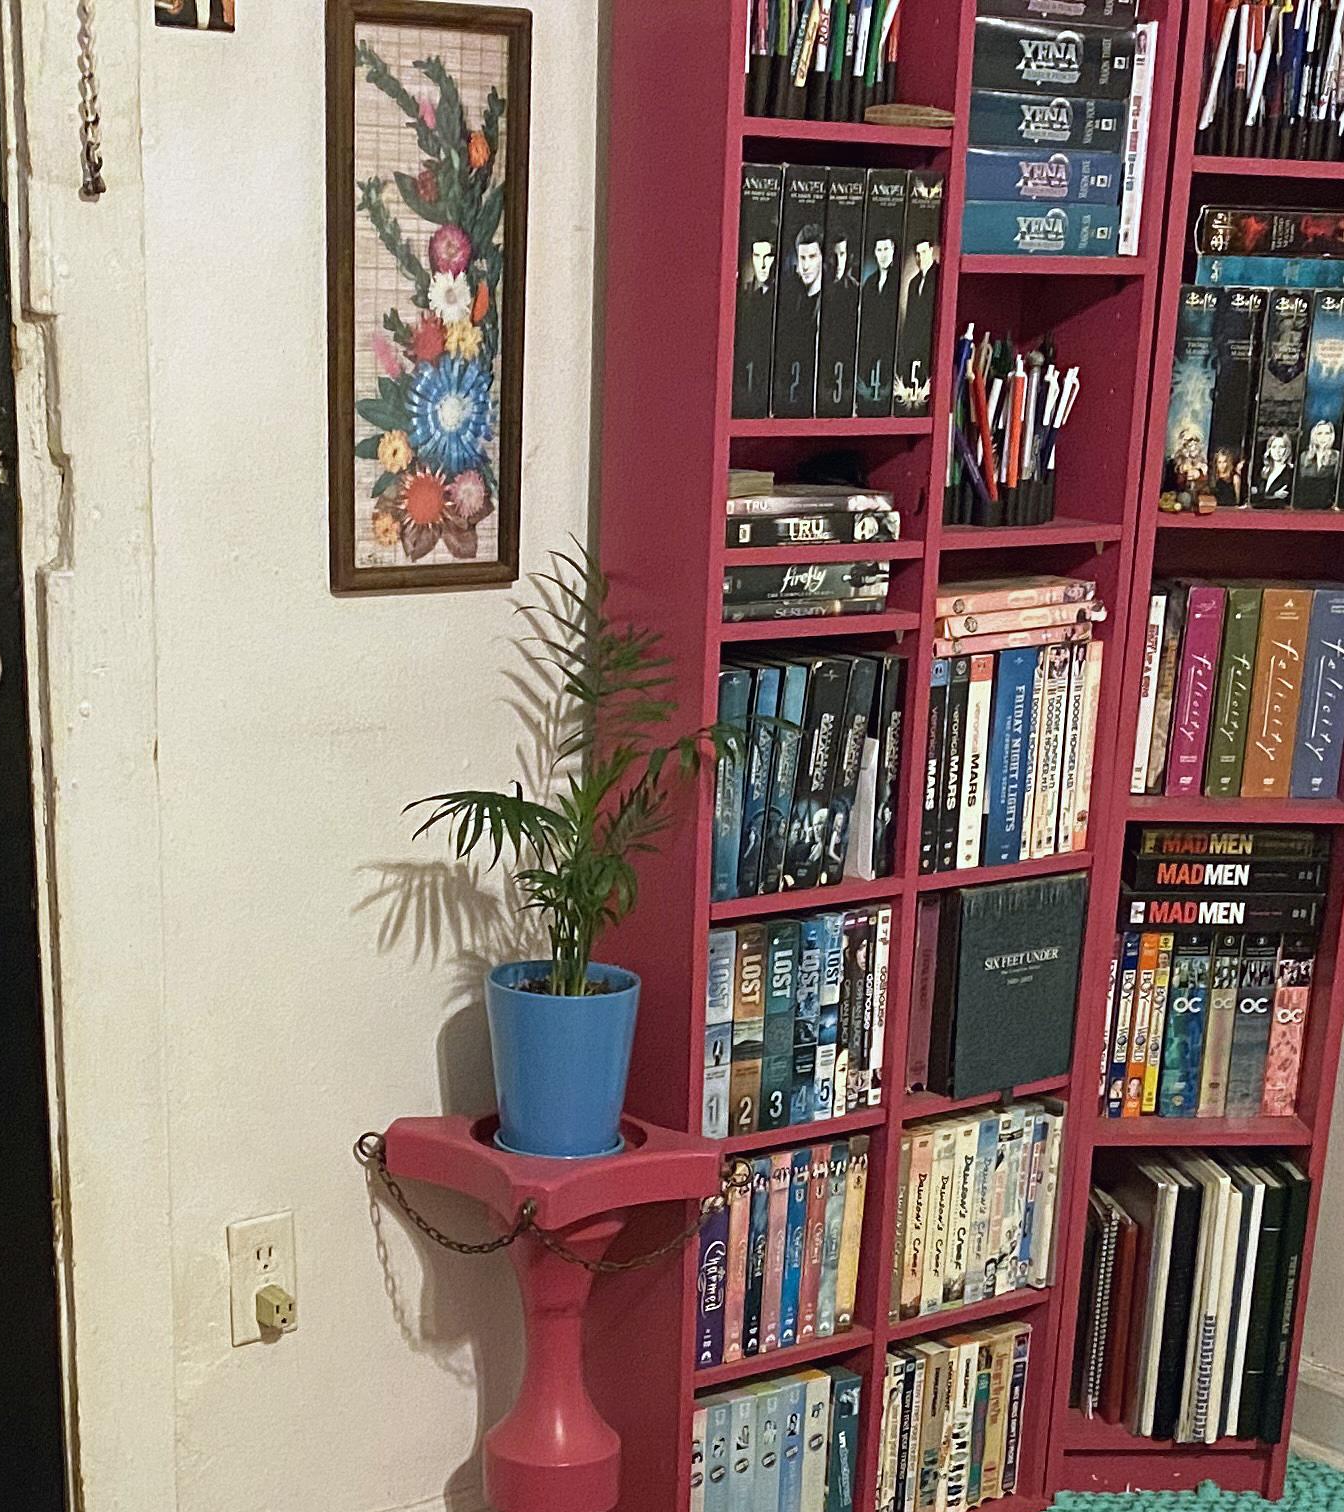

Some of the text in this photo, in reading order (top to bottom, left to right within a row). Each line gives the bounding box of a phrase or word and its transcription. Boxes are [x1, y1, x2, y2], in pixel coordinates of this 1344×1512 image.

[1016, 39, 1080, 70] XENA
[1018, 105, 1070, 130] XENA
[742, 177, 780, 190] ANGEL
[789, 180, 826, 193] ANGEL
[829, 181, 864, 194] ANGEL
[1015, 161, 1068, 188] XENA
[871, 184, 905, 196] ANGEL
[1013, 217, 1066, 241] XENA
[1185, 292, 1217, 312] Buffy
[1231, 293, 1262, 313] Buffy
[1275, 297, 1308, 319] Buffy
[833, 361, 843, 403] 3
[870, 360, 881, 401] 4
[788, 519, 825, 536] TRU
[780, 565, 827, 592] firefly
[774, 607, 827, 618] SERENITY
[1180, 654, 1212, 742] felicity
[1220, 654, 1251, 742] felicity
[1256, 640, 1299, 761] felicity
[1071, 694, 1081, 731] DOOGIE
[1005, 684, 1025, 833] FRIDAY NIGHT LIGHTS
[826, 949, 840, 987] LOST
[985, 947, 1059, 970] SIX FEET UNDER
[709, 957, 730, 1009] LOST
[741, 954, 762, 1006] LOST
[773, 949, 793, 999] LOST
[878, 966, 888, 1028] dollhouse
[1173, 997, 1202, 1013] OC
[1214, 998, 1233, 1009] OC
[1240, 998, 1269, 1013] OC
[1277, 1008, 1304, 1024] OC
[792, 1086, 807, 1112] 4
[820, 1078, 830, 1101] 5
[739, 1097, 752, 1125] 2
[769, 1090, 783, 1118] 3
[911, 1173, 927, 1278] Dawson's Creek
[954, 1154, 974, 1270] Dawson's Creek
[933, 1176, 950, 1278] Dawson's Creek
[704, 1240, 727, 1312] Charmed
